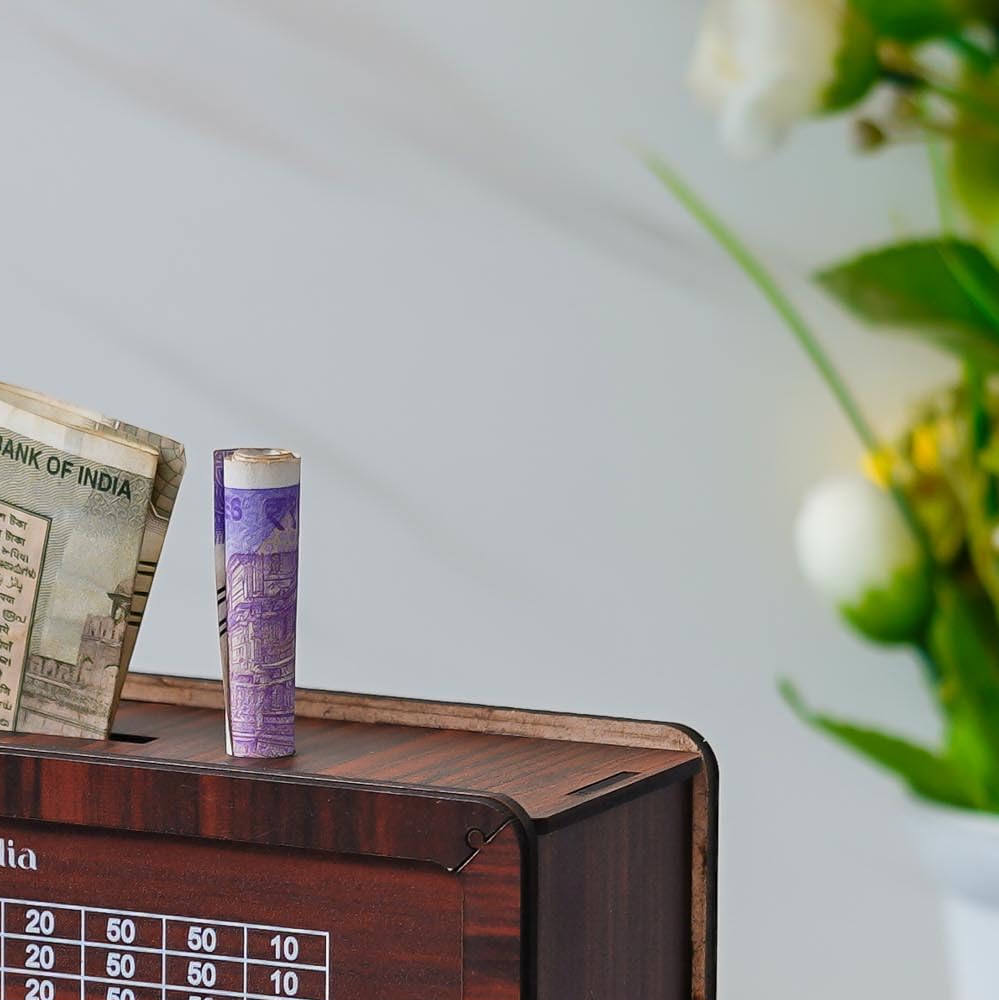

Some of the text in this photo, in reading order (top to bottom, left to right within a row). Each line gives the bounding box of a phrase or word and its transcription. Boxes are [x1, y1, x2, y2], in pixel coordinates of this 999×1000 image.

[46, 455, 74, 479] OF
[77, 465, 132, 500] INDIA
[25, 908, 55, 936] 20
[106, 917, 136, 944] 50
[187, 925, 217, 953] 50
[270, 934, 299, 961] 10
